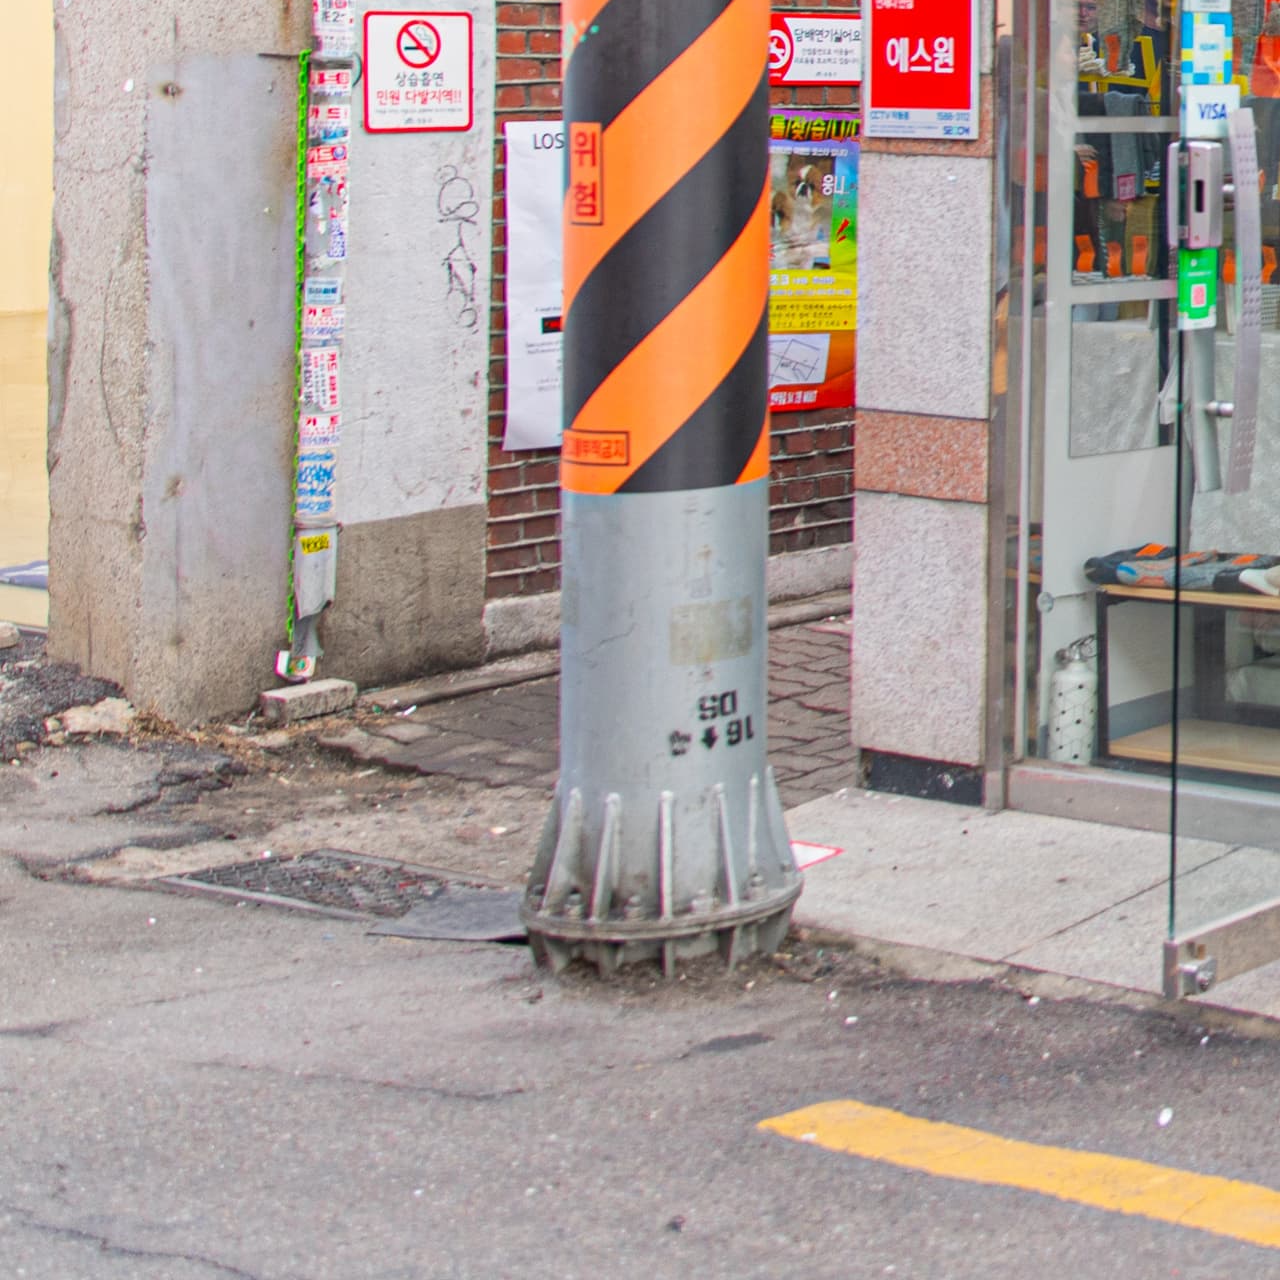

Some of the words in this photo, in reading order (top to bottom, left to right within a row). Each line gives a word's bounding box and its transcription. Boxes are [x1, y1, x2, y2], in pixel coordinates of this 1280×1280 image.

[886, 36, 955, 74] 에스원
[395, 71, 445, 88] 상습흡연
[376, 89, 401, 106] 민원
[1198, 103, 1228, 121] VISA
[533, 132, 565, 151] LOS
